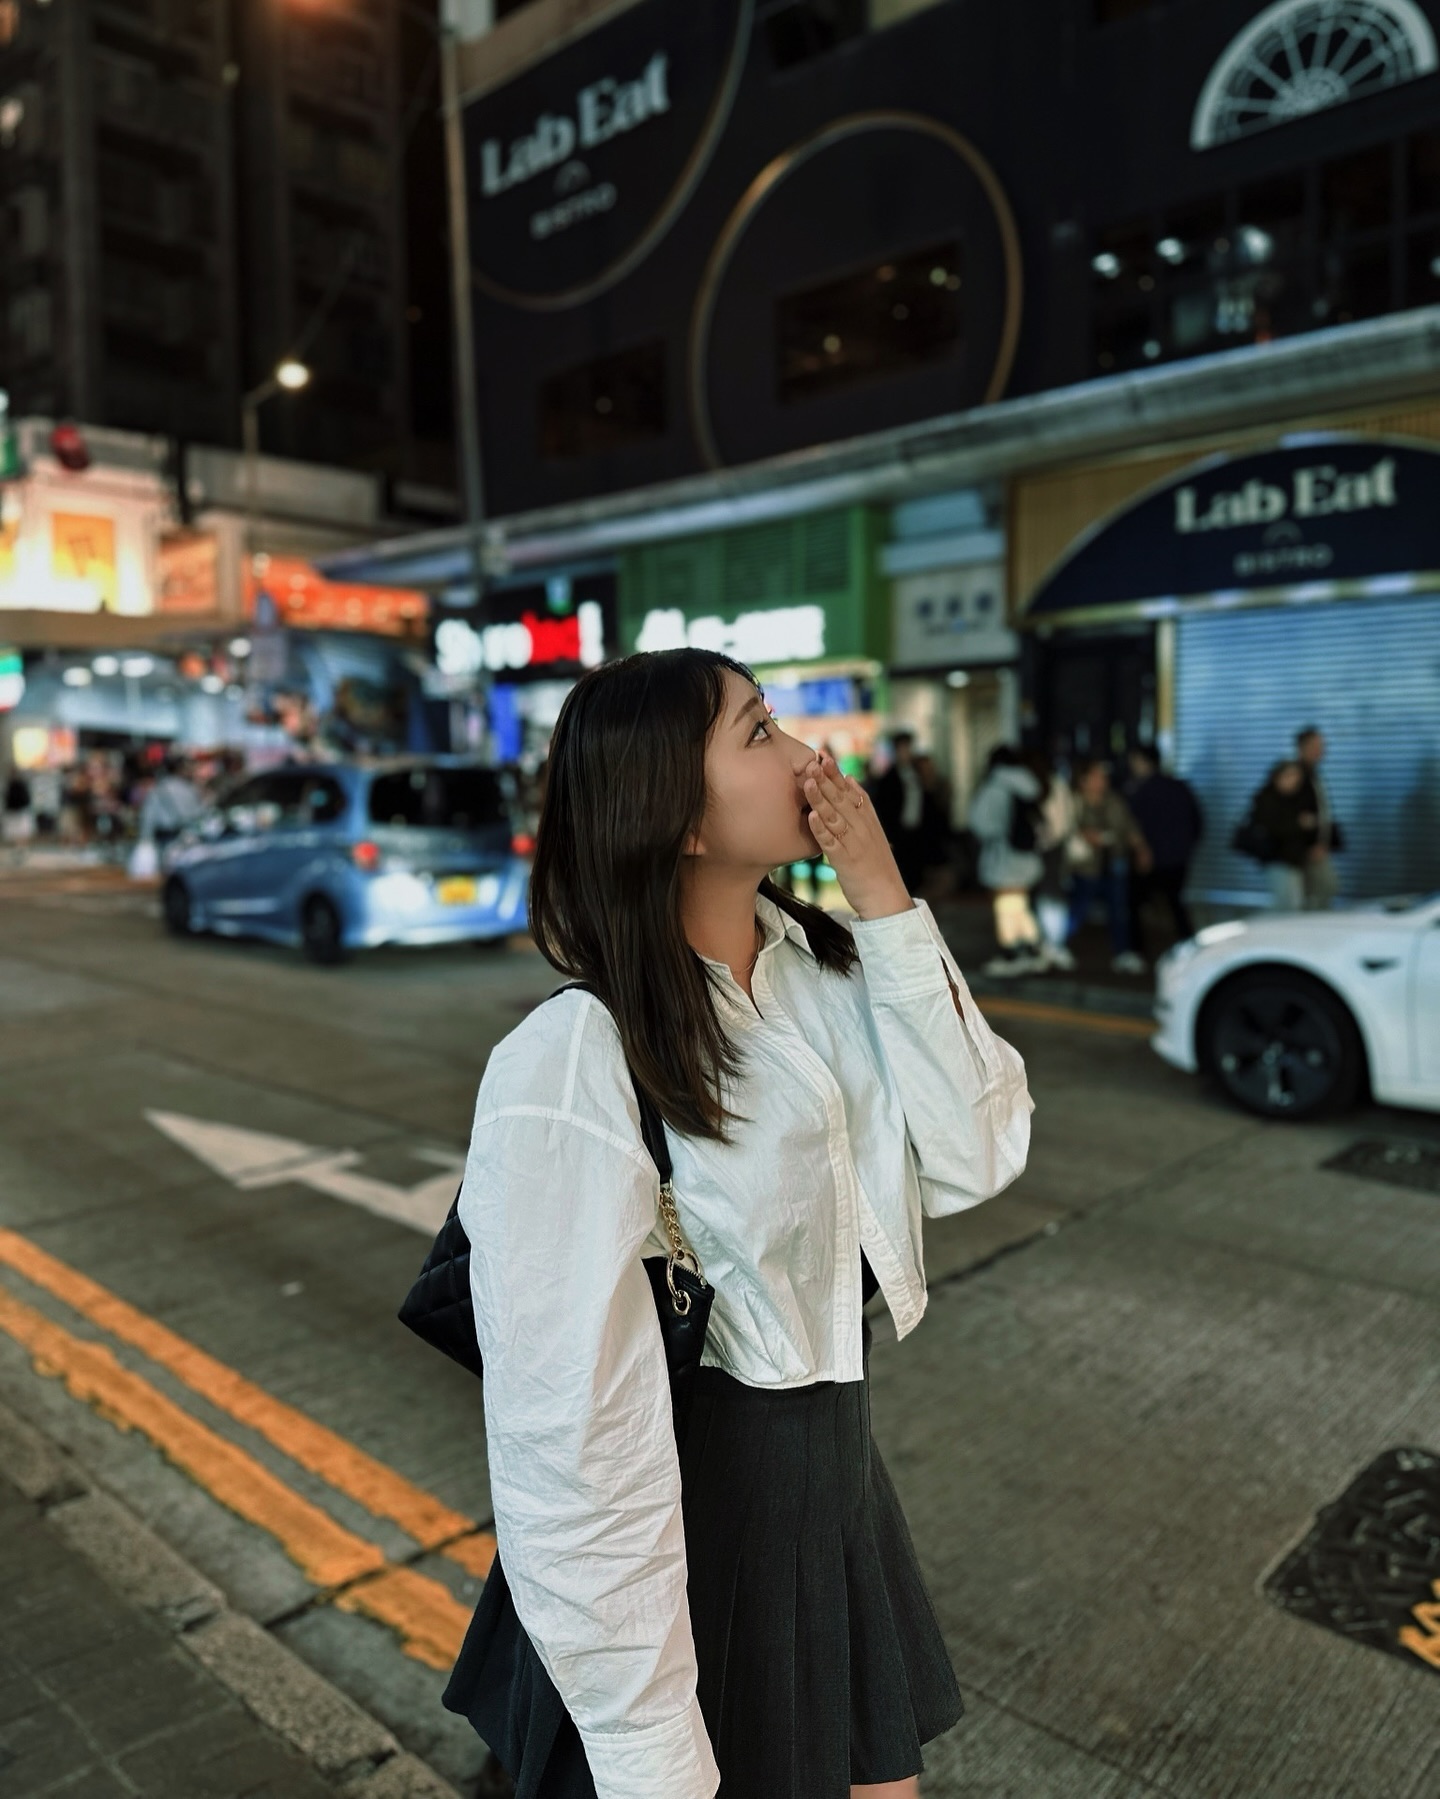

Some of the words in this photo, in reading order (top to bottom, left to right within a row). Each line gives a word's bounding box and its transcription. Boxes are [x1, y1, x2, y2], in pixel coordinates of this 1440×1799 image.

[481, 114, 575, 195] Lab
[578, 53, 668, 148] Eat
[1175, 479, 1285, 533] Lab
[1294, 457, 1396, 518] Eat
